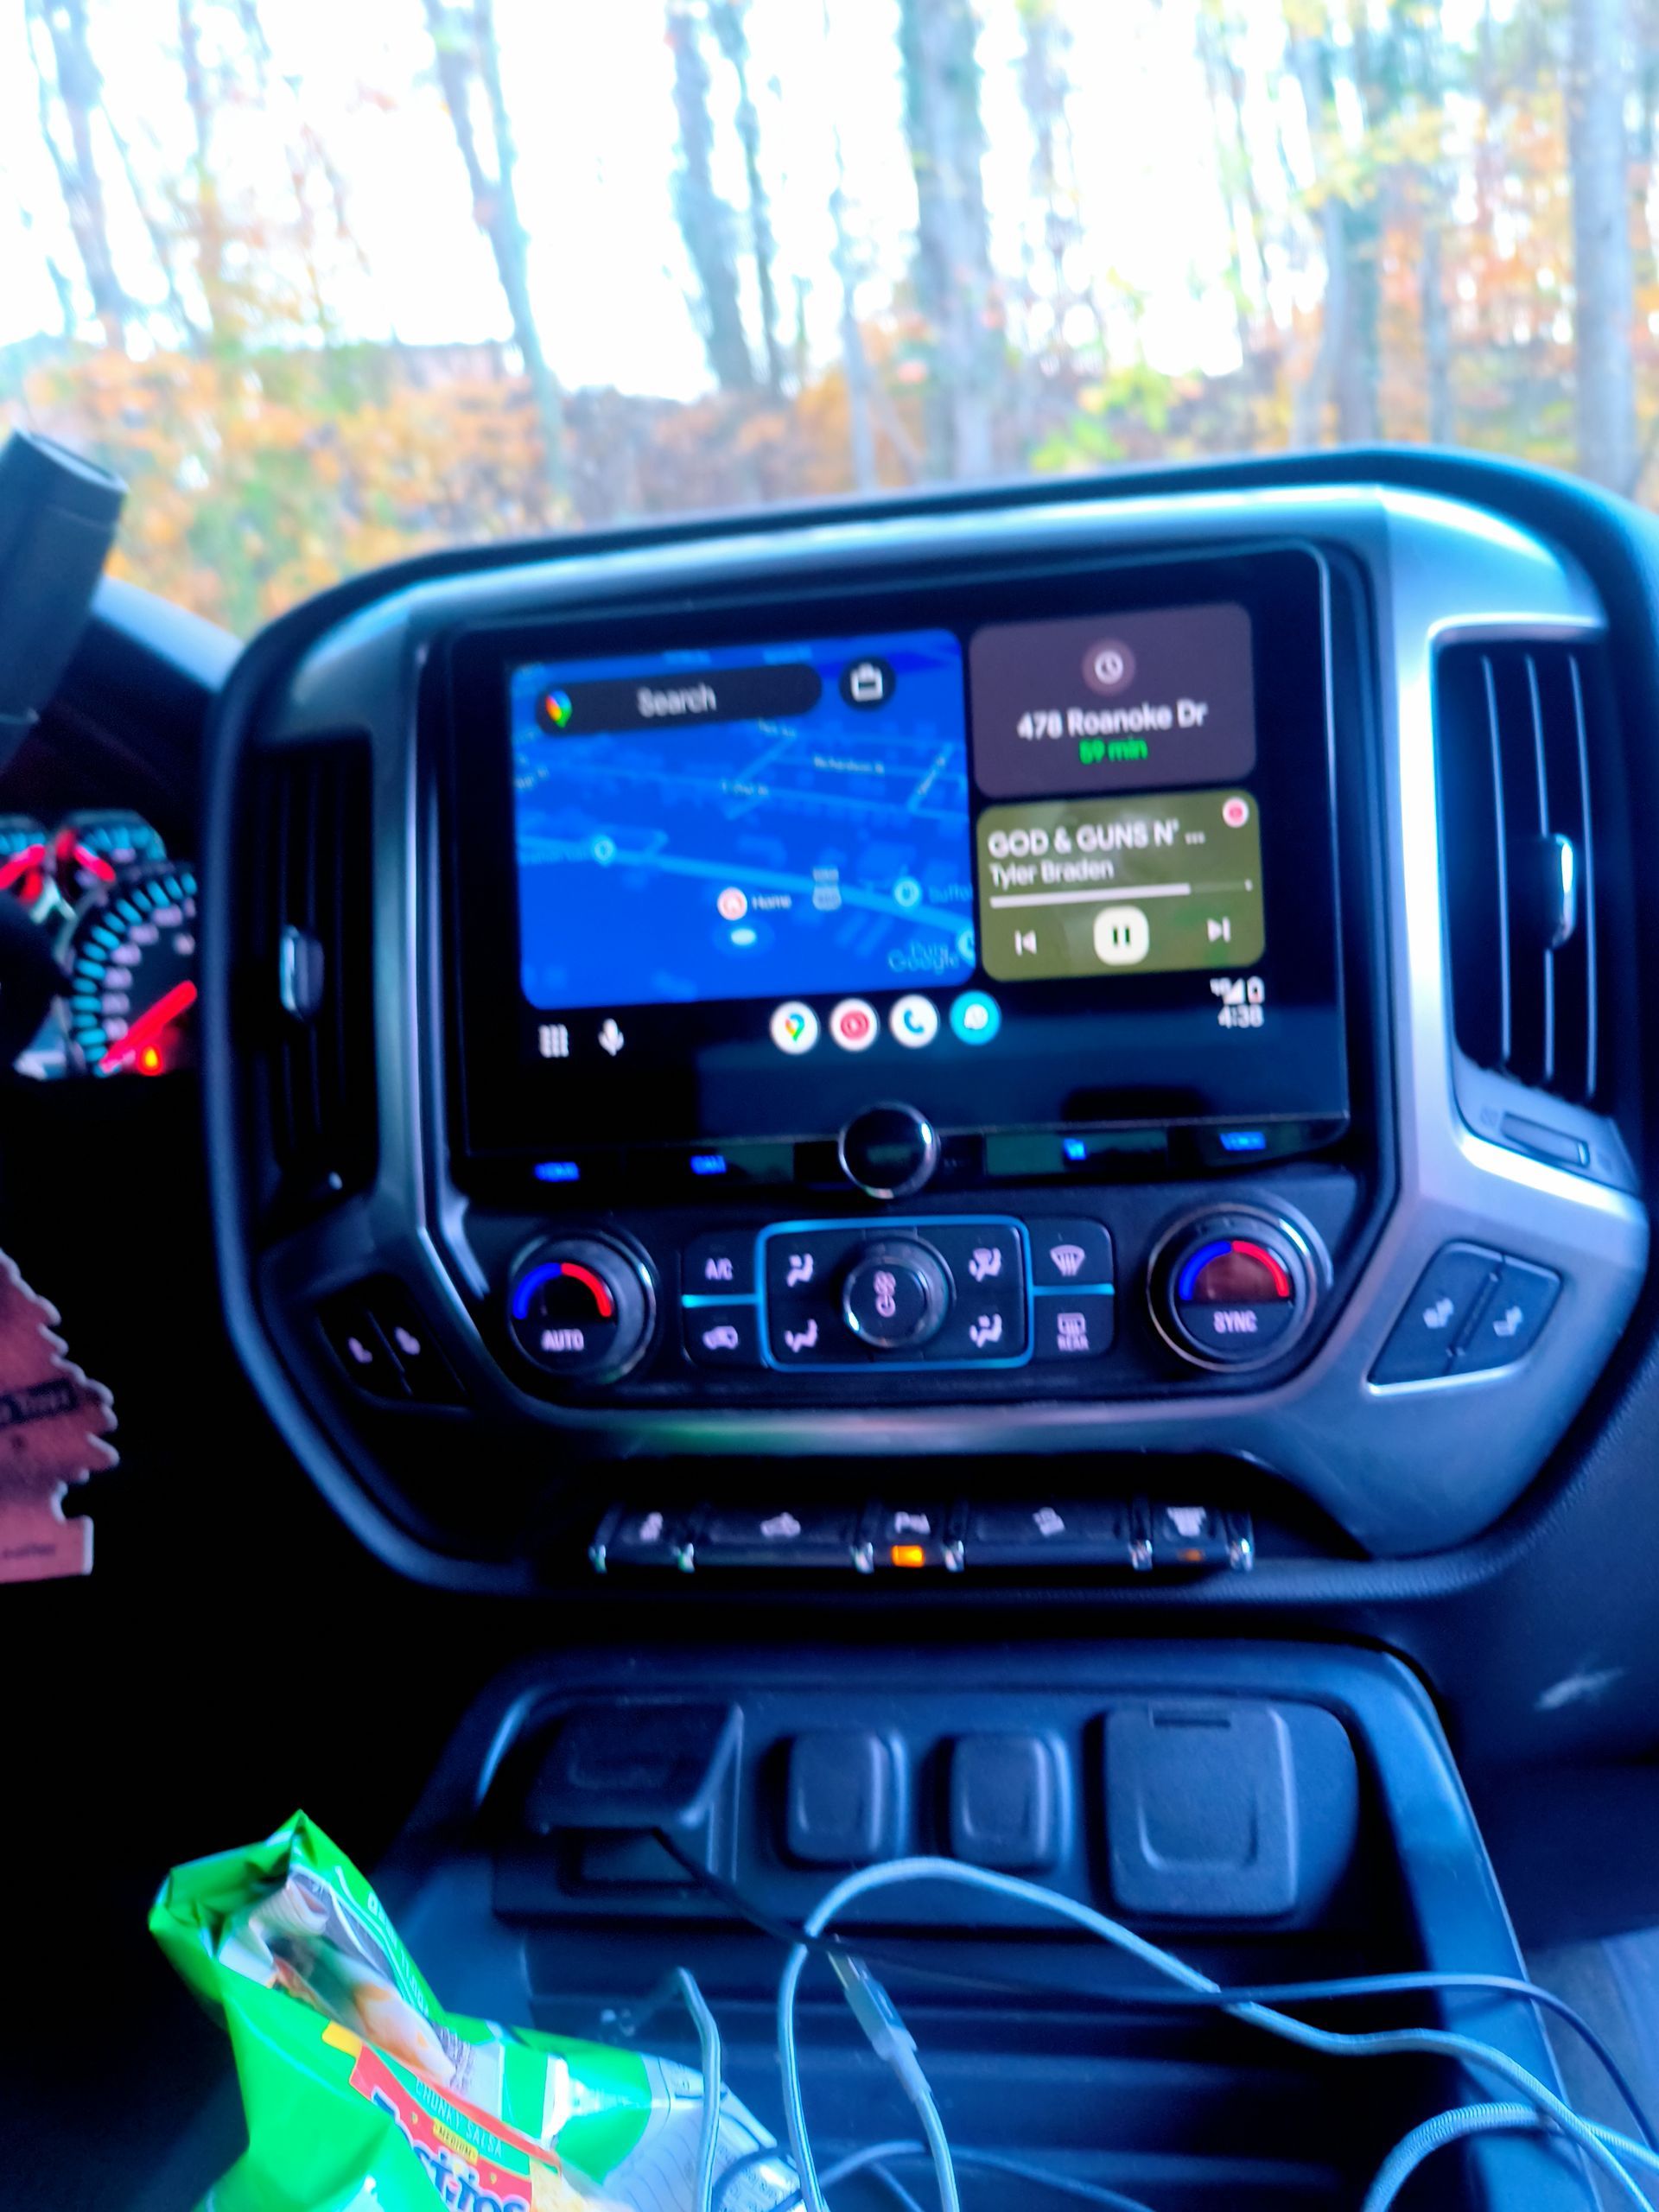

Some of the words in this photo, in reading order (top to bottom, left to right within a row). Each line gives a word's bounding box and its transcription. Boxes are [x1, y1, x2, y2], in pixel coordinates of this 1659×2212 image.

[638, 681, 716, 718] Search
[1067, 701, 1173, 737] Roanoke
[1176, 697, 1208, 728] Dr
[1108, 734, 1148, 761] min
[988, 829, 1049, 858] GOD
[1054, 825, 1072, 855] &
[1076, 820, 1149, 854] GUNS
[989, 861, 1036, 891] Tyler
[1040, 859, 1115, 885] Braden
[1212, 1310, 1258, 1335] SYNC
[541, 1328, 585, 1352] AUTO
[415, 2077, 461, 2132] CHUNKY
[465, 2119, 503, 2158] SALSA
[437, 2126, 474, 2158] MEDIUM
